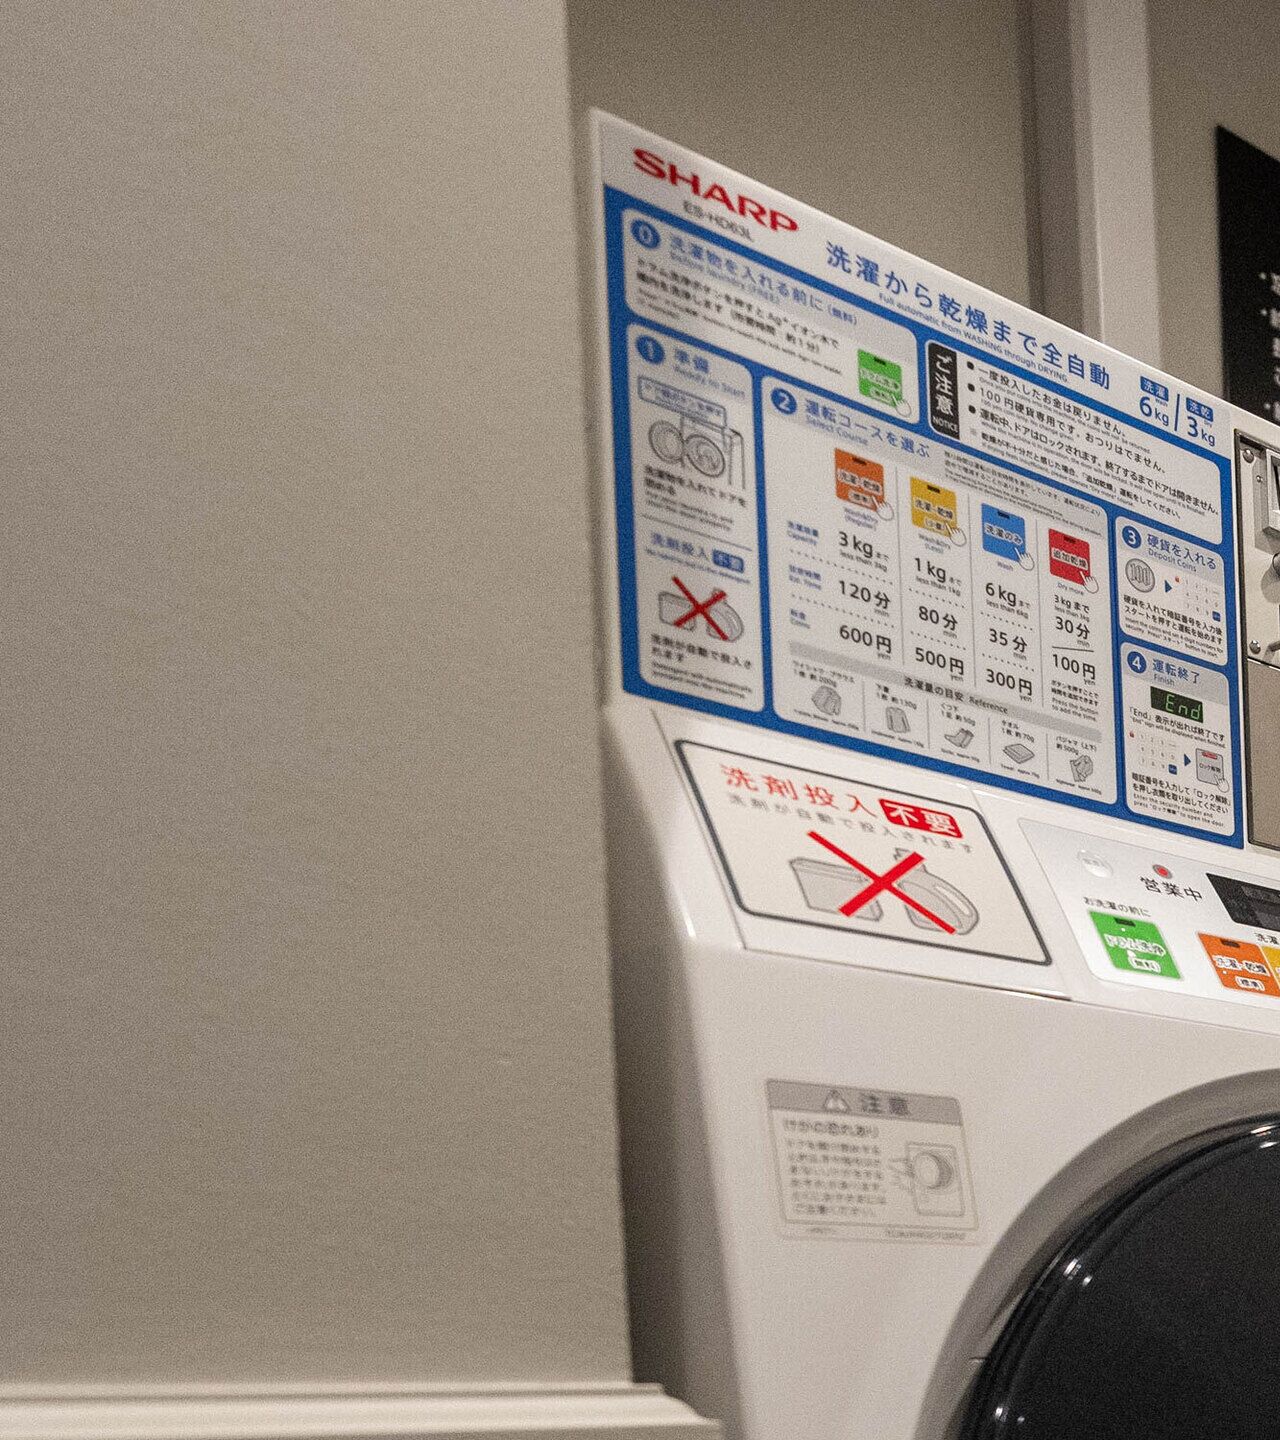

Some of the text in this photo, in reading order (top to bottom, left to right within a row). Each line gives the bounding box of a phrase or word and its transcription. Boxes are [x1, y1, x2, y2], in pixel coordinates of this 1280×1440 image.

[633, 148, 799, 232] SHARP
[826, 241, 1110, 390] 洗濯から乾燥まで全自動
[804, 398, 929, 460] 運転コースを選ぶ
[932, 414, 959, 433] NOTICE
[1146, 532, 1216, 571] 硬貨を入れる
[1148, 547, 1196, 572] Deposit Coins
[838, 578, 1090, 654] 120分 80分 35分 30分
[838, 623, 1095, 696] 600円 500円 300円 100円
[1152, 657, 1200, 685] 運転終了
[1153, 673, 1174, 686] Finish
[1164, 692, 1200, 720] End
[720, 764, 960, 837] 洗剤投入 不要
[1140, 876, 1203, 902] 営業中
